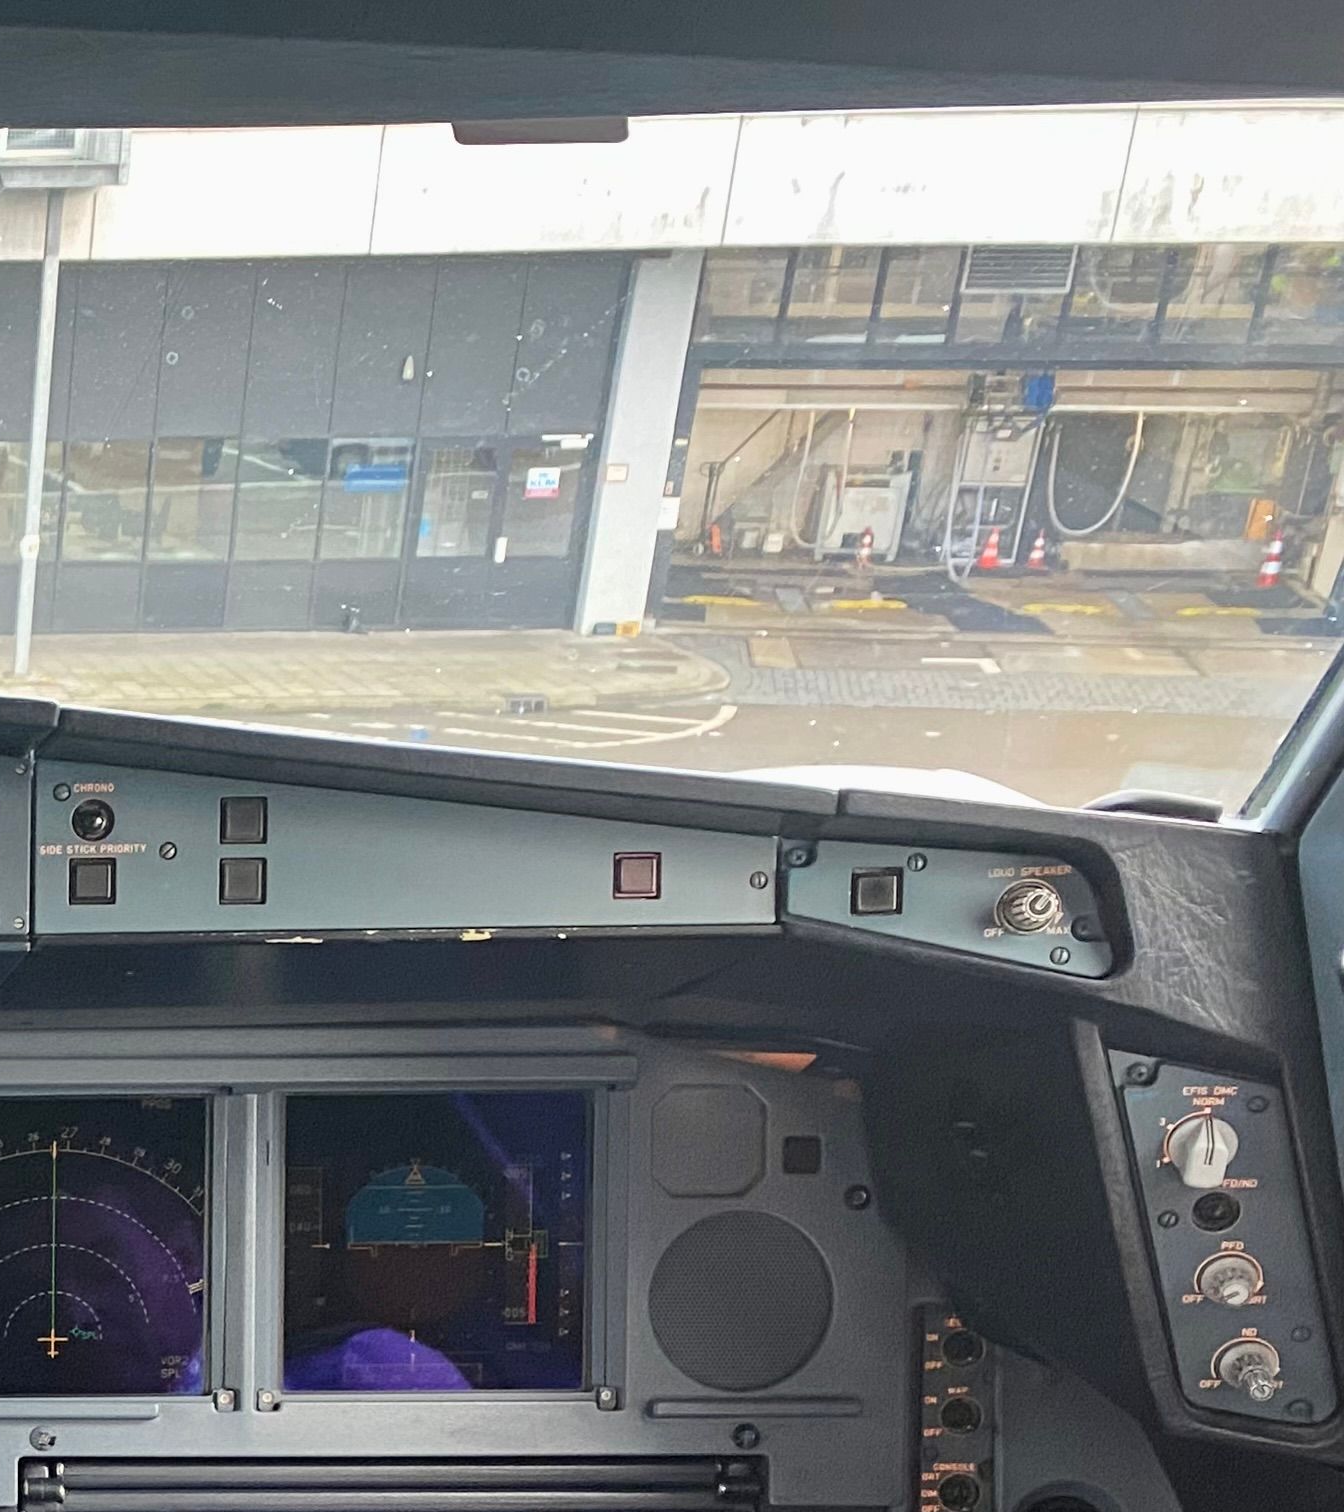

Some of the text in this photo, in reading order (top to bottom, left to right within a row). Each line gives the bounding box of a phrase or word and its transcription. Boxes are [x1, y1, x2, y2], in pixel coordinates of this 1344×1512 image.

[73, 783, 115, 793] CHRONO
[40, 844, 147, 855] SIDE STICK PRIORITY
[1183, 1086, 1238, 1096] EFIS DMC
[1193, 1097, 1225, 1106] NORM
